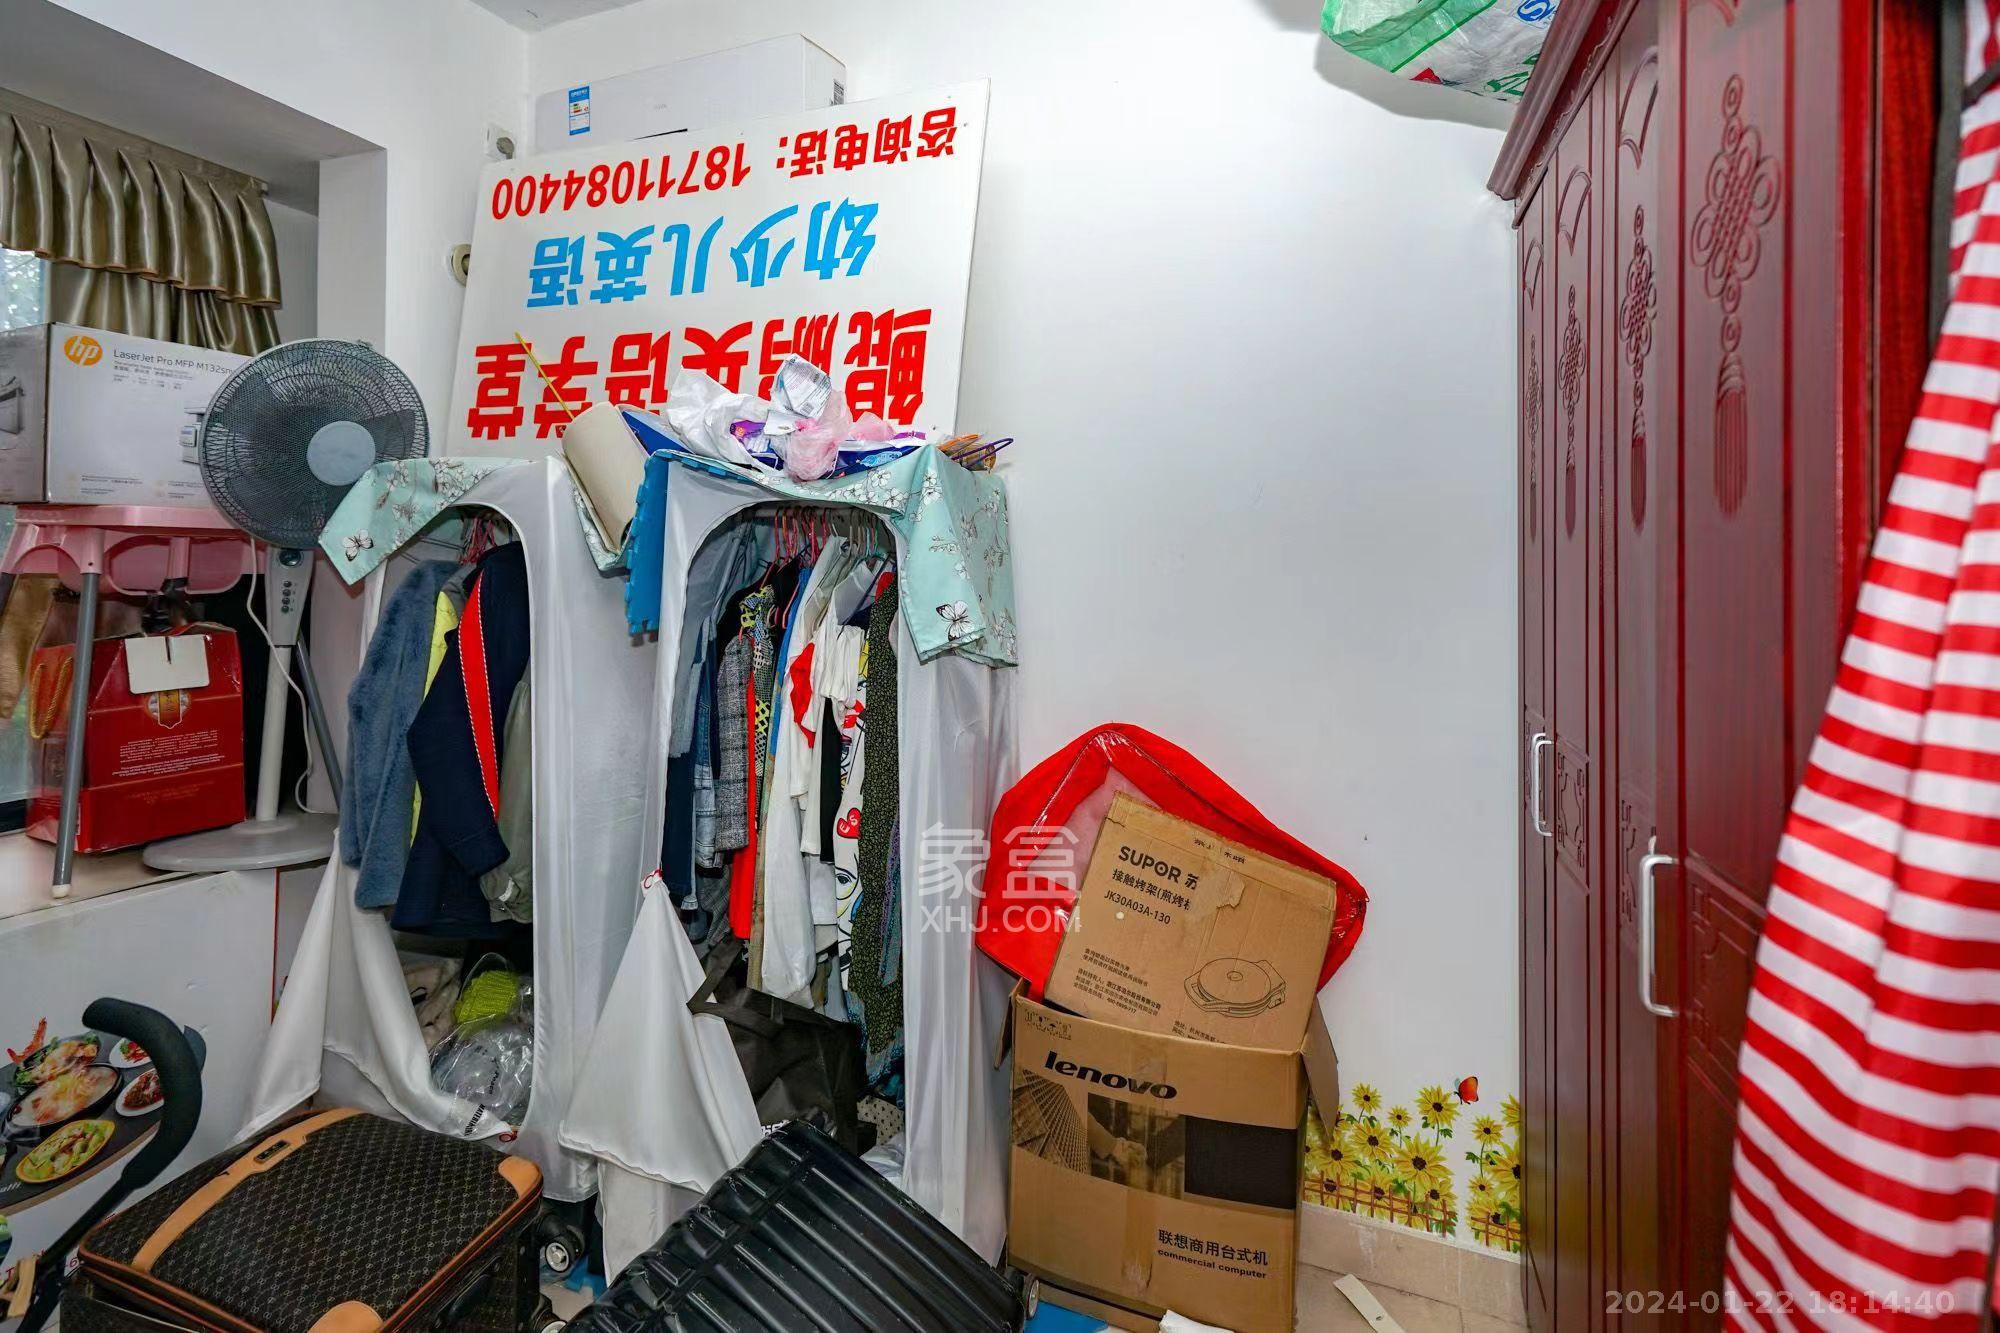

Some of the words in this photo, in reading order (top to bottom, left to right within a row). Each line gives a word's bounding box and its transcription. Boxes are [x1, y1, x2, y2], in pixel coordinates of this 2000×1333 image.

[526, 197, 879, 308] 幼少儿英语
[68, 336, 101, 366] hp
[113, 349, 154, 364] LaserJet
[156, 355, 173, 367] Pro
[175, 358, 195, 369] MFP
[1118, 845, 1182, 884] SUPOR
[1104, 889, 1171, 925] JK30A03A-130
[1044, 1050, 1178, 1100] lenovo
[1157, 1229, 1269, 1267] 联想商用台式机
[1157, 1249, 1216, 1270] commercial
[1217, 1263, 1267, 1280] computer
